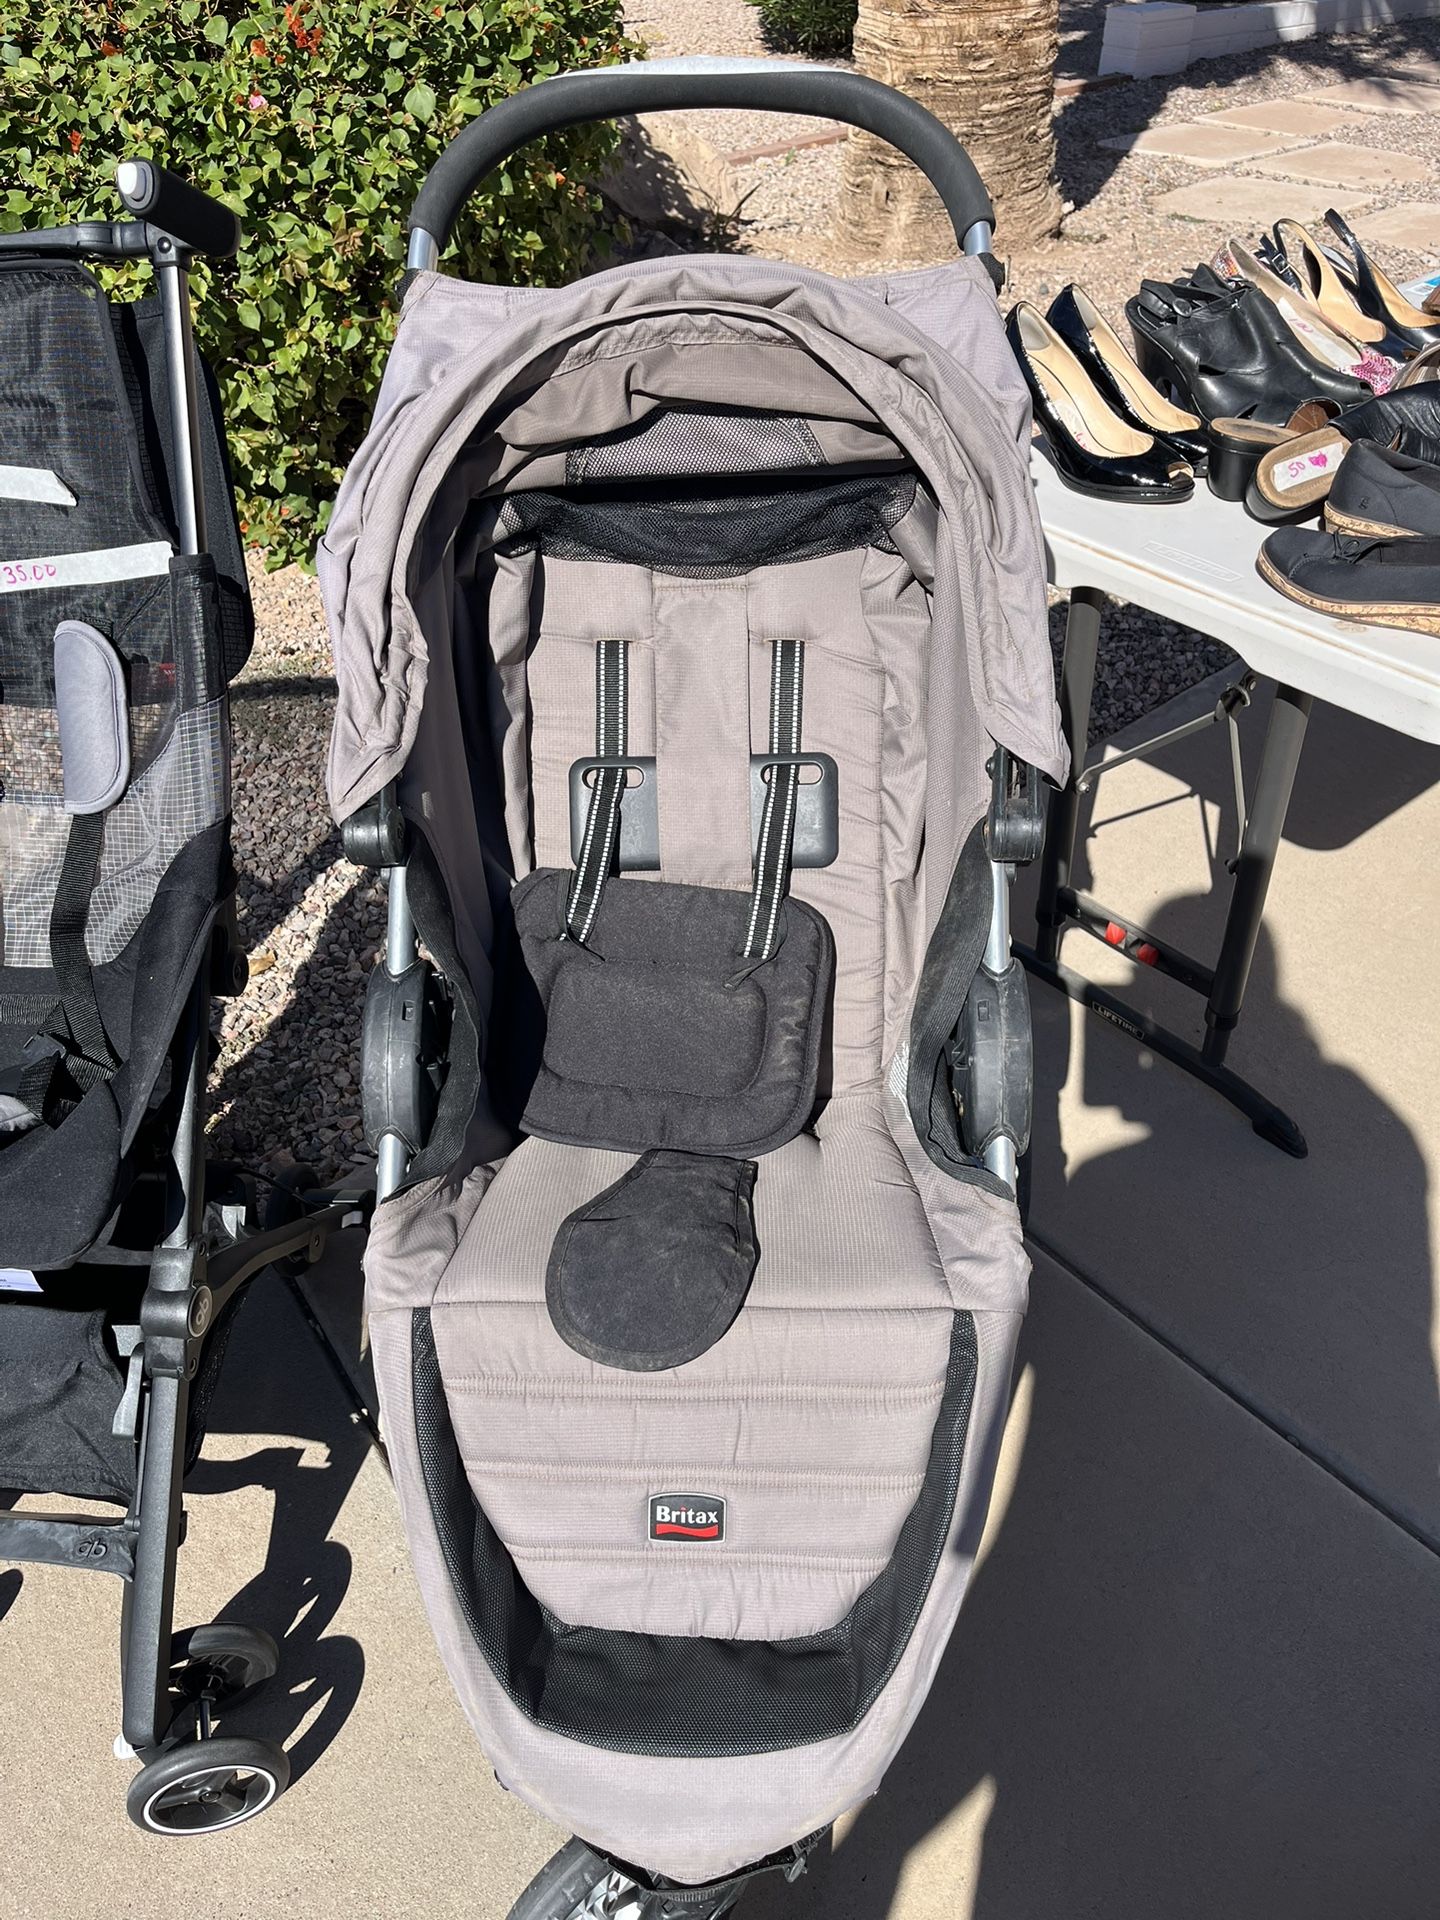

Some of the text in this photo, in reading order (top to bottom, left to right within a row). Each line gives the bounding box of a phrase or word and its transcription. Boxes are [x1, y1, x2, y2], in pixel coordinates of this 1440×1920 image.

[3, 564, 56, 584] 35.00
[1097, 1005, 1138, 1034] LIFETIME
[656, 1504, 719, 1524] Britax
